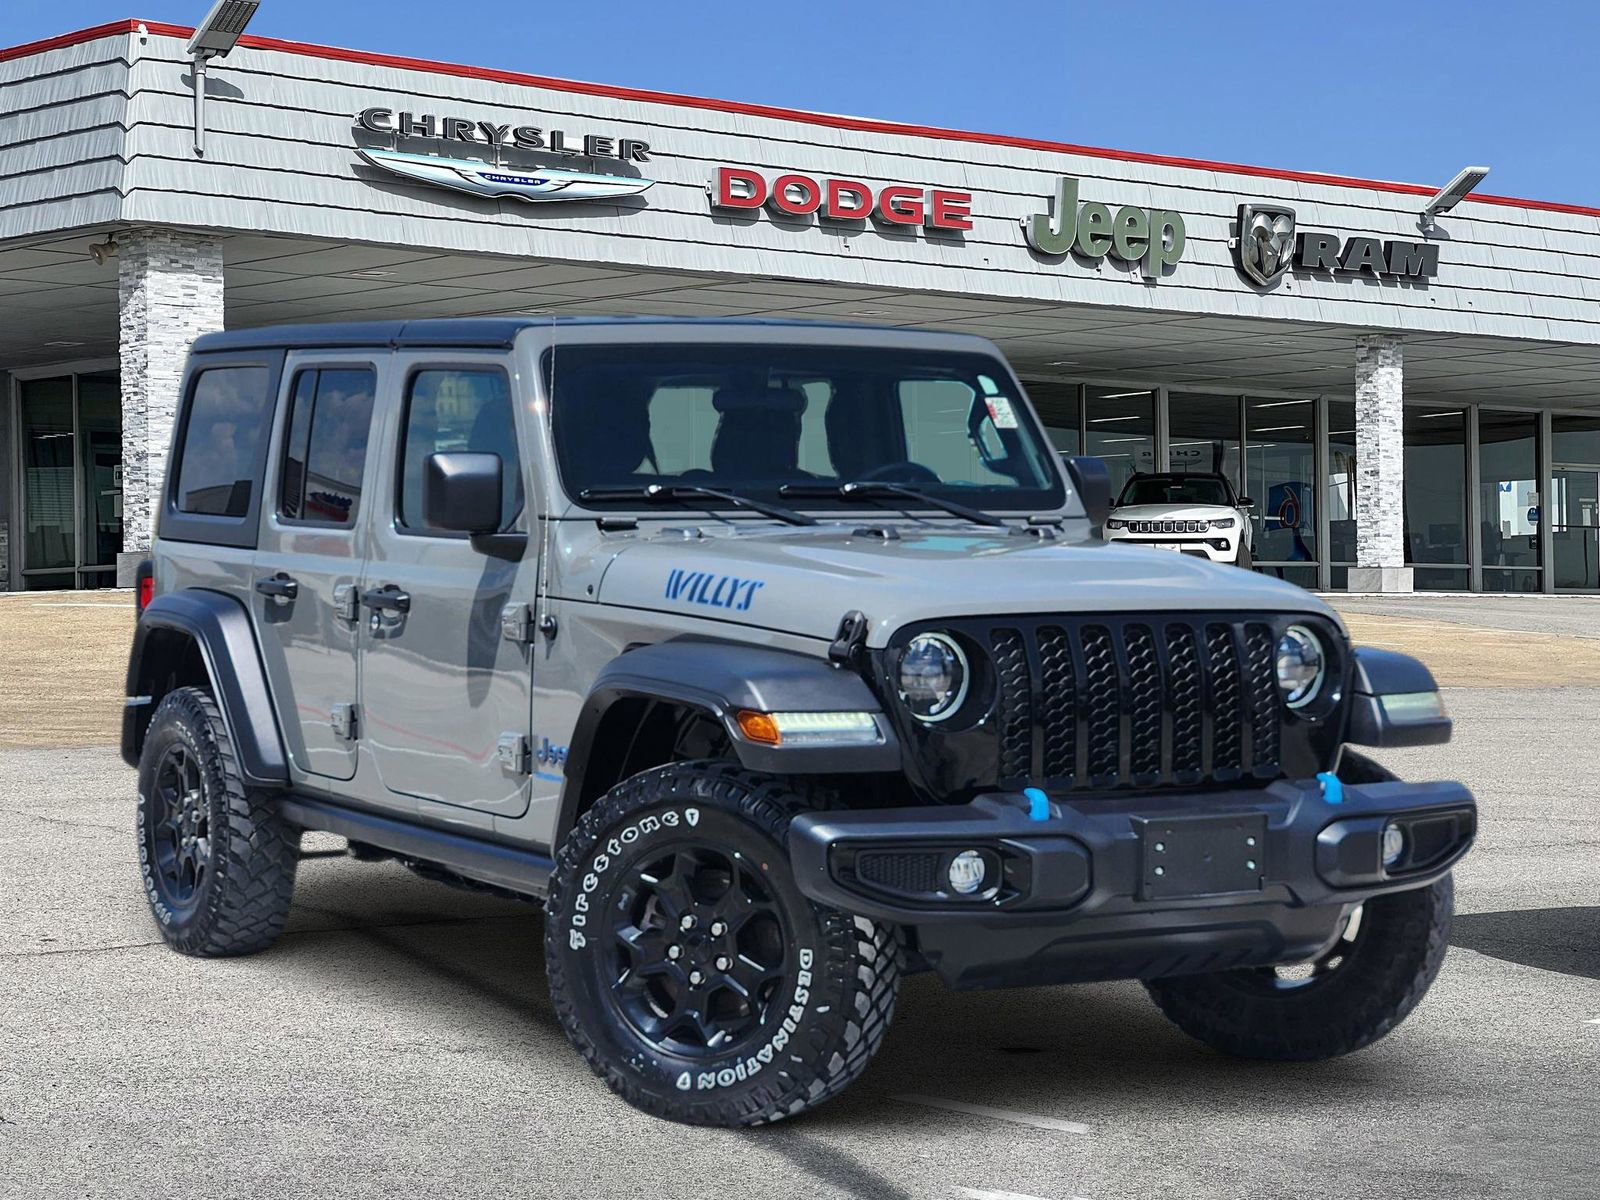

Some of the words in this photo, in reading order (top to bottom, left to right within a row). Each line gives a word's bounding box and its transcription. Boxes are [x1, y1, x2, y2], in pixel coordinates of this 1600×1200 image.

[356, 106, 652, 162] CHRYSLER
[484, 174, 541, 185] CHRYSLER
[714, 167, 973, 230] DODGE
[1028, 177, 1186, 278] Jeep
[1296, 232, 1440, 277] RAM
[665, 569, 765, 611] WILLYS
[569, 810, 679, 950] Firestone
[697, 948, 814, 1090] DESTINATION
